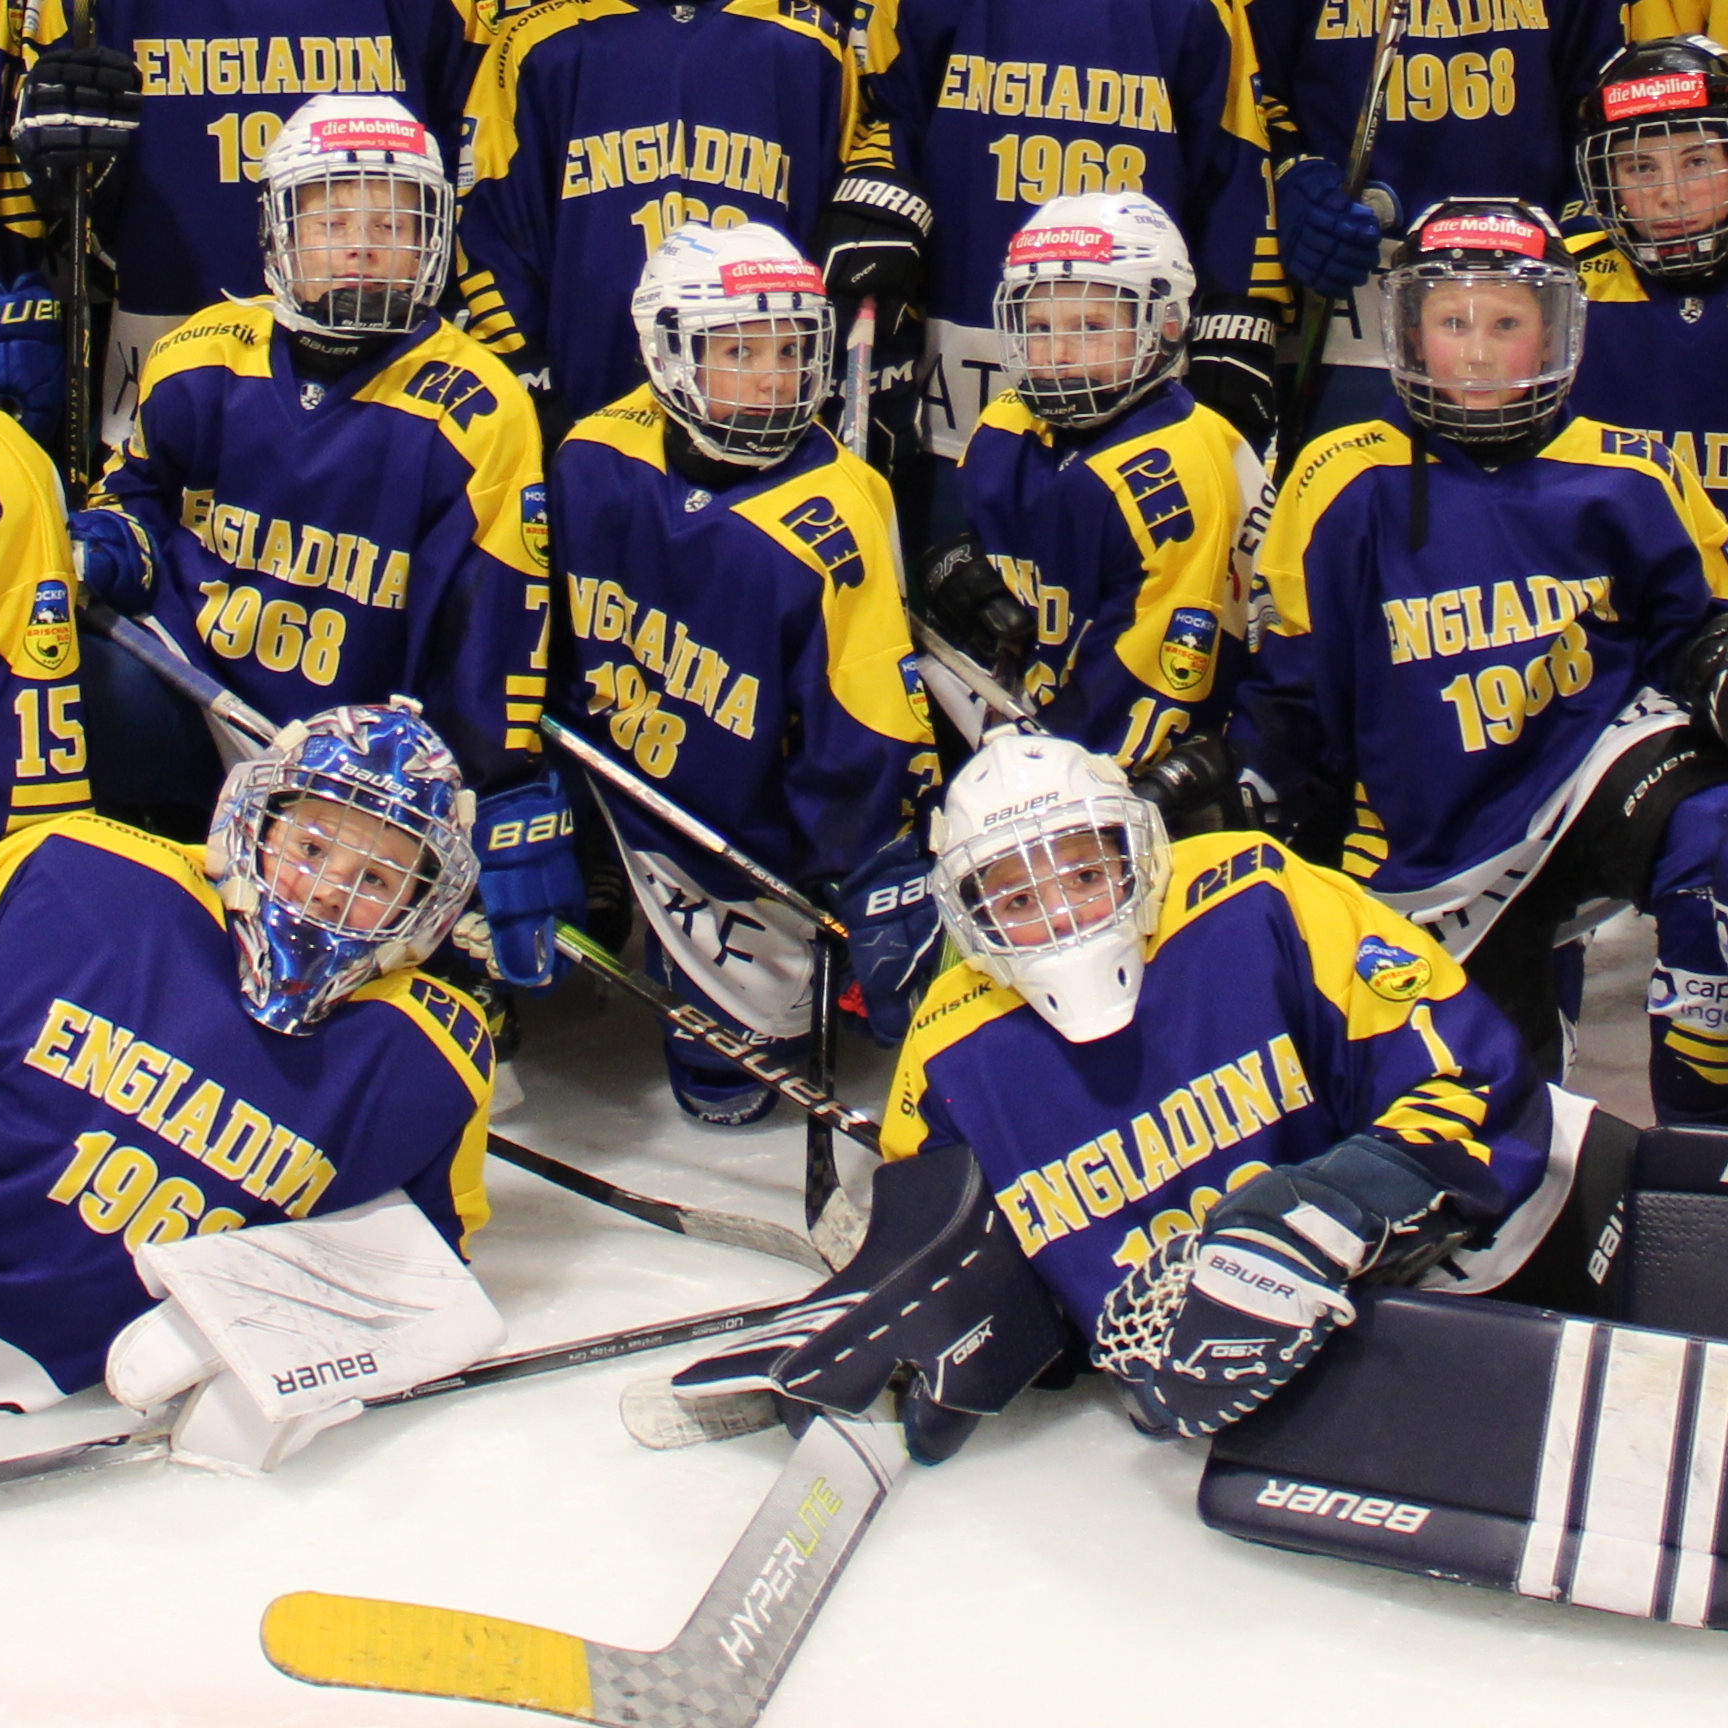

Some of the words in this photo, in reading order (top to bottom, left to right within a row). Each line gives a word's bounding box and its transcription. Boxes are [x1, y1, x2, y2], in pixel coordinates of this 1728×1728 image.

[134, 37, 406, 97] ENGIADIN
[937, 53, 1177, 135] ENGIADIN
[1388, 47, 1517, 122] 1968
[1632, 78, 1697, 98] Mobiliar
[349, 121, 417, 139] Mobiliar
[989, 133, 1147, 204] 1968
[1038, 228, 1103, 246] Mobiliar
[195, 579, 347, 688] 1968
[14, 683, 89, 778] 15
[1411, 1003, 1462, 1077] 1
[995, 1032, 1315, 1260] ENGIADINA
[1210, 1340, 1268, 1358] GSX
[717, 1476, 844, 1668] HYPERLITE
